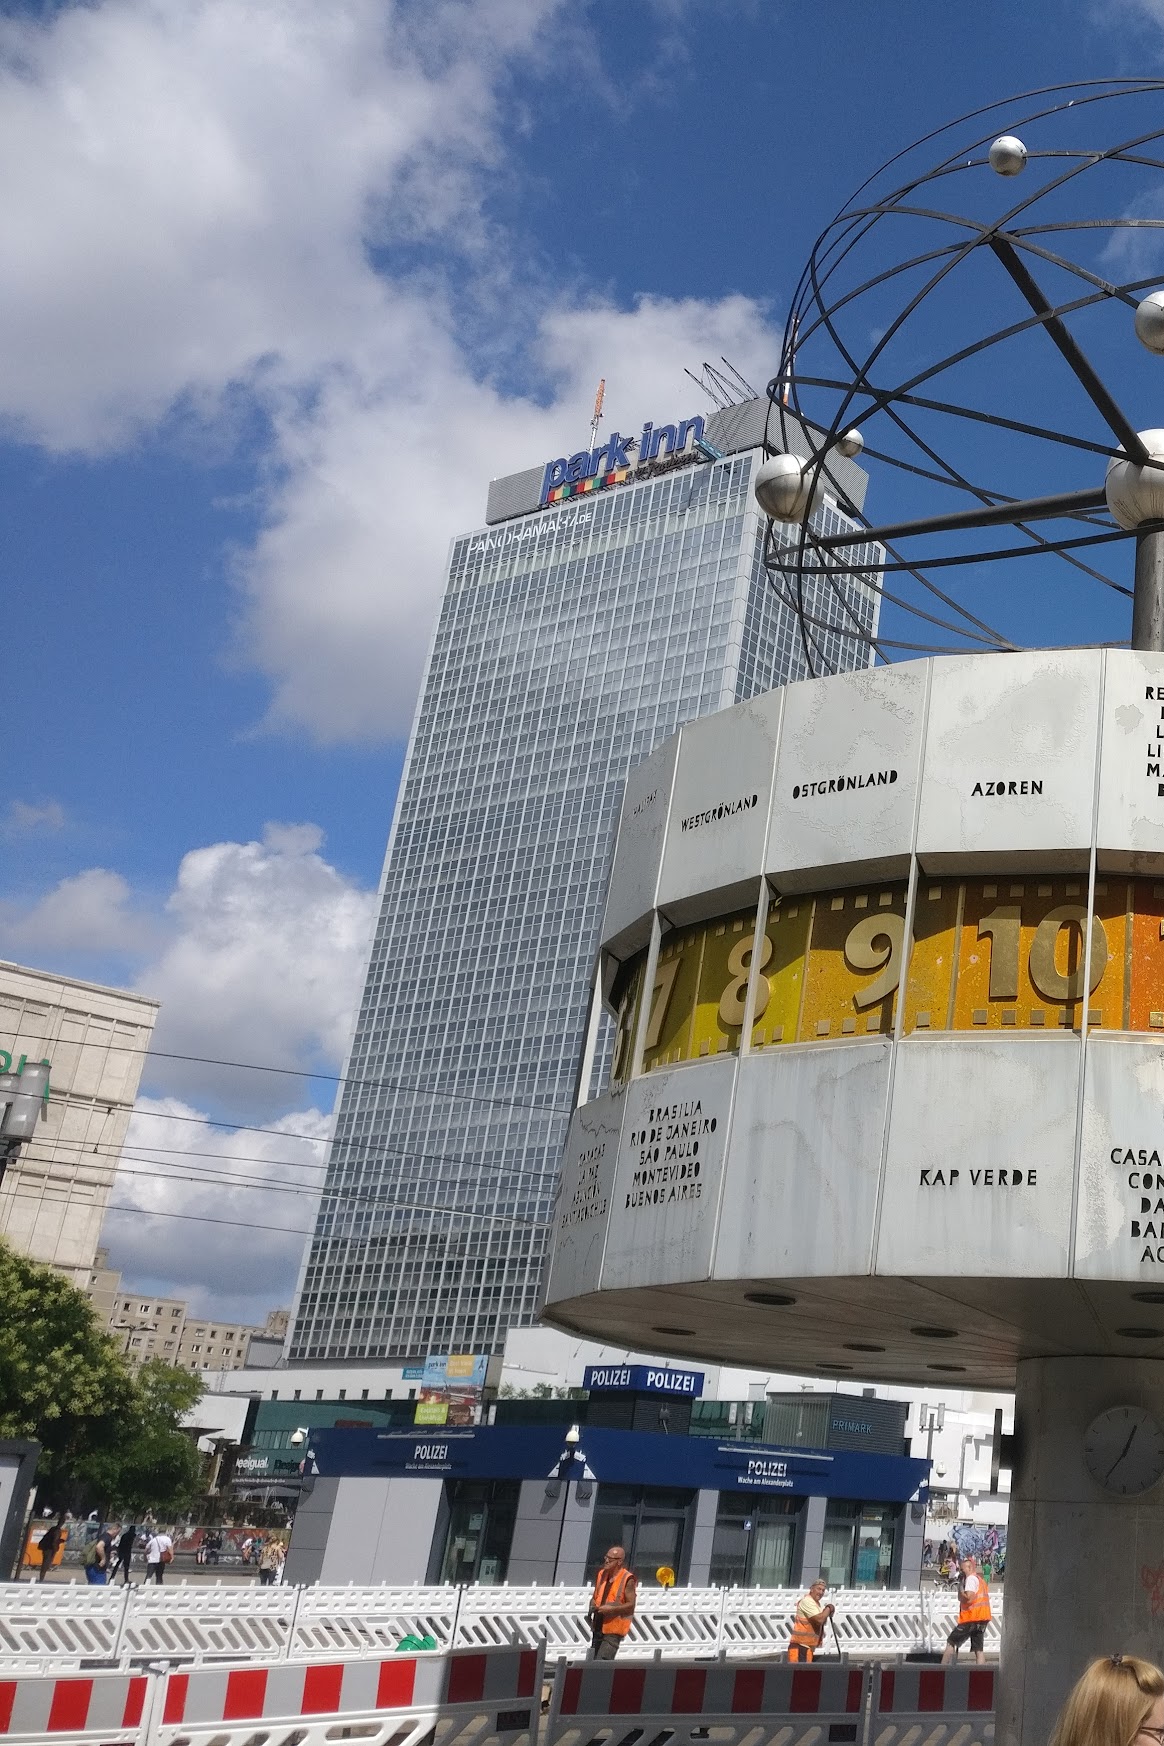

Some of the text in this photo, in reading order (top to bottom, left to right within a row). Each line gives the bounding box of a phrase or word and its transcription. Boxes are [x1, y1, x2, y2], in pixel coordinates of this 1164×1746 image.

[539, 415, 705, 505] park inn
[792, 769, 898, 800] OSTGRÖNLAND
[971, 780, 1043, 796] AZOREN
[681, 794, 758, 832] WESTGRÖNLAND
[843, 912, 914, 1008] 9
[977, 904, 1109, 1001] 10
[717, 934, 773, 1026] 8
[648, 1100, 702, 1124] BRASILIA
[630, 1117, 717, 1147] RIO DE JANEIRO
[664, 1141, 699, 1161] PAULO
[632, 1162, 701, 1187] MONTEVIDEO
[919, 1169, 1037, 1186] KAP VERDE
[625, 1183, 703, 1209] BUENOS AIRES
[590, 1370, 631, 1386] POLIZEI
[646, 1370, 695, 1392] POLIZEI
[832, 1419, 872, 1435] PRIMARK
[414, 1445, 448, 1460] POLIZEI
[747, 1460, 788, 1478] POLIZEI
[737, 1476, 794, 1488] Wache am Alexanderplatz
